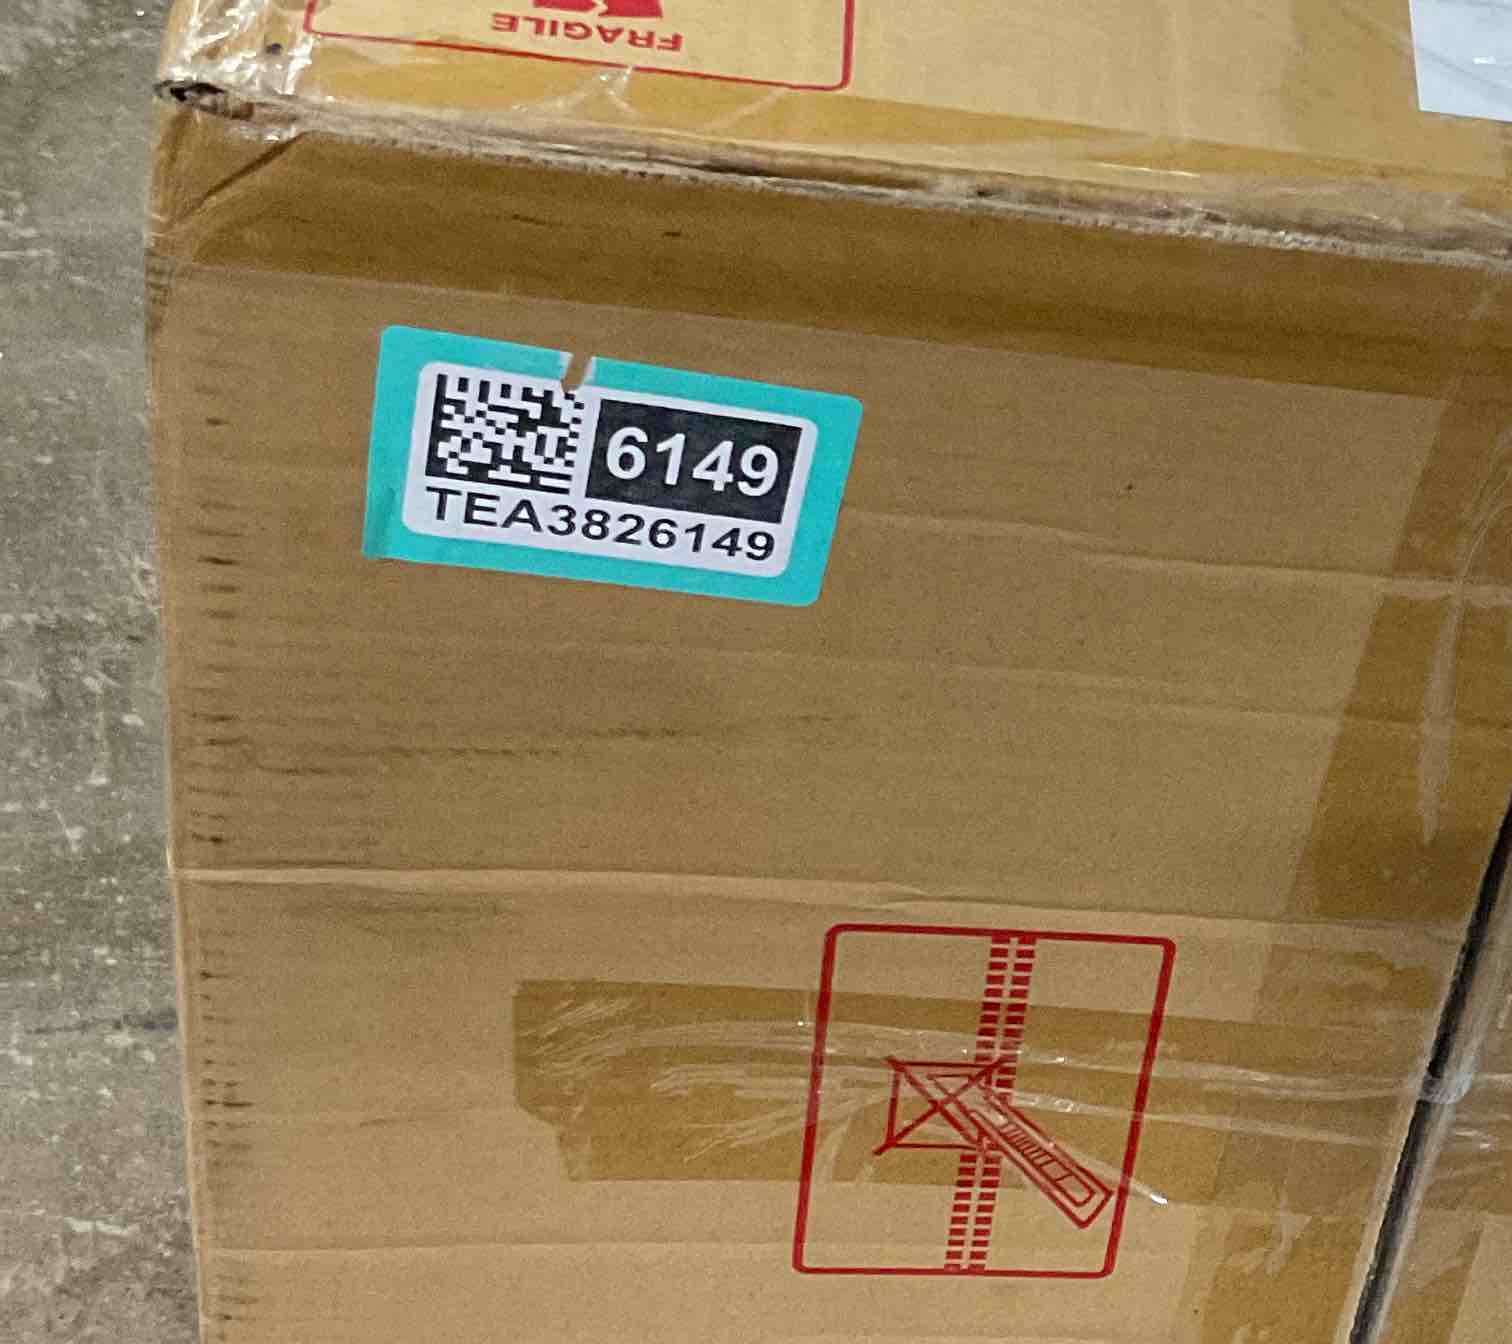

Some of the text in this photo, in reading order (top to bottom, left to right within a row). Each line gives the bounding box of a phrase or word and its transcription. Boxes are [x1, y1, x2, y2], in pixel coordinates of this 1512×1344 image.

[490, 13, 683, 51] FRAGILE
[607, 426, 780, 497] 6149
[425, 486, 775, 562] TEA3826149
